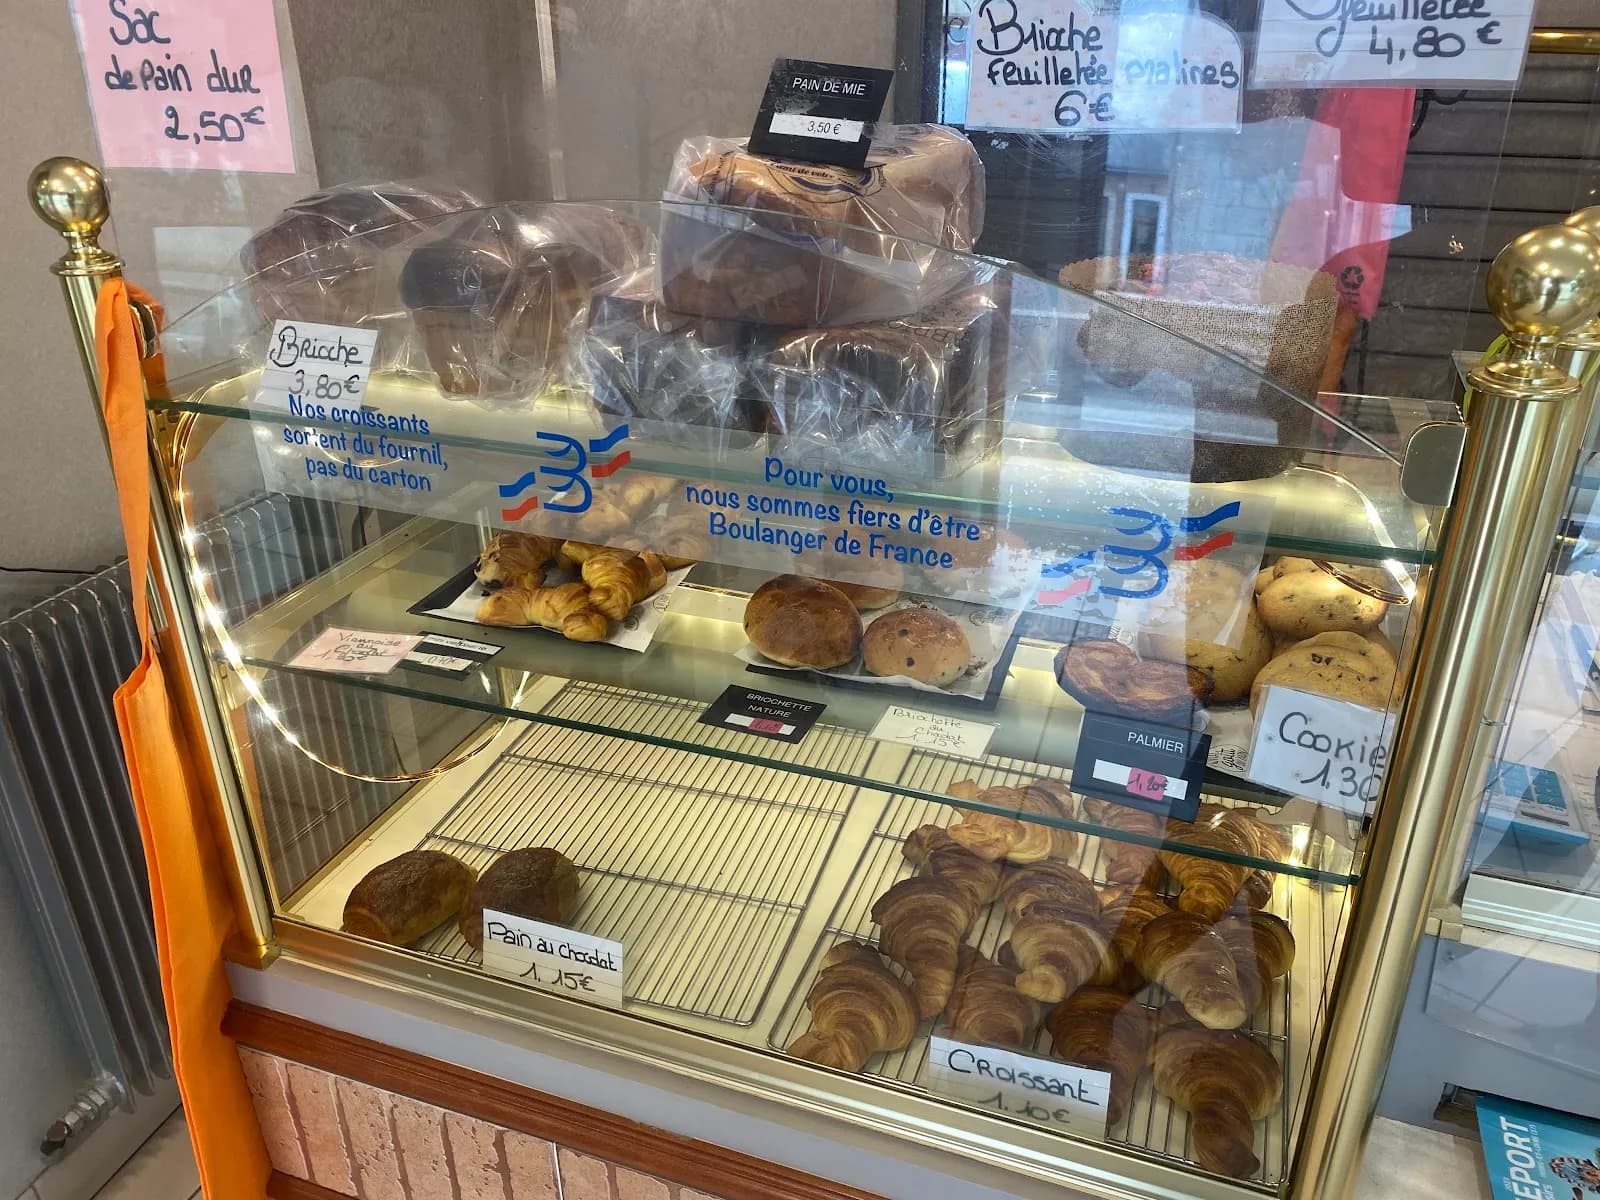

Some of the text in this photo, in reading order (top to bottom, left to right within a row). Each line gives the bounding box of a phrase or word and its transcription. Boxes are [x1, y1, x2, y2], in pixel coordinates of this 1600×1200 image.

[109, 0, 171, 45] Sac
[792, 77, 867, 96] PAIN DE MIE
[288, 394, 431, 436] Nos croissants
[283, 427, 449, 471] sortent du fournil,
[305, 456, 432, 492] pas du carton
[764, 457, 895, 503] Pour vous,
[686, 484, 981, 541] nous sommes fiers d'être
[708, 511, 954, 569] Boulanger de France
[746, 693, 812, 713] BRIOCHETTE
[747, 704, 792, 719] NATURE
[1128, 731, 1184, 754] PALMIER
[488, 922, 532, 949] Pain
[537, 938, 554, 955] au
[1499, 1115, 1543, 1200] EPORT
